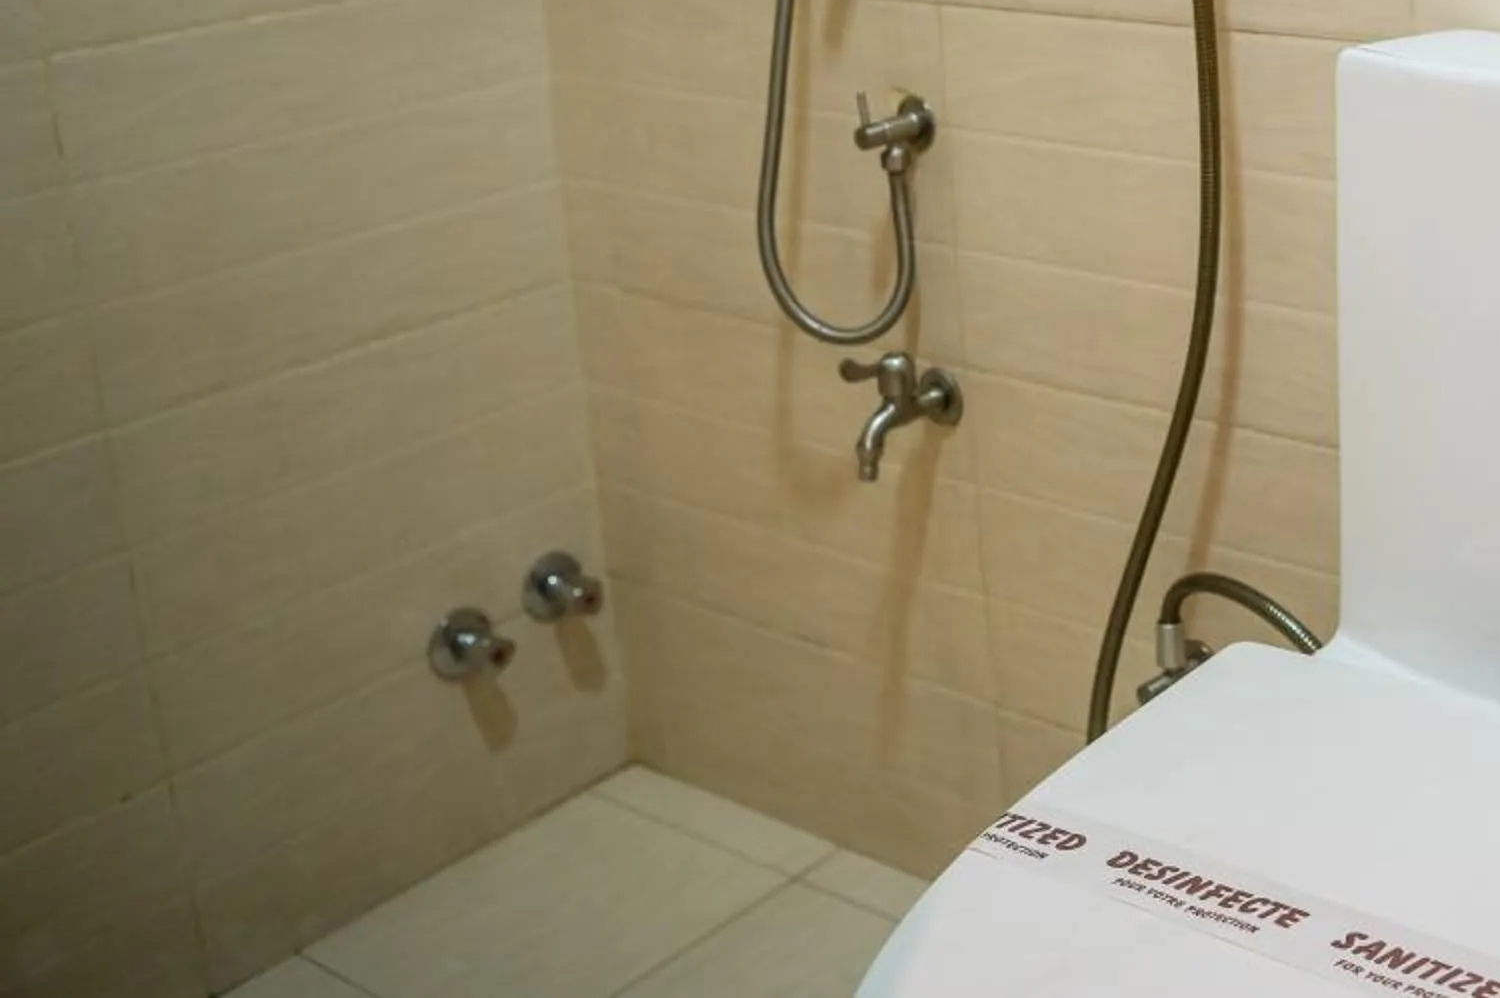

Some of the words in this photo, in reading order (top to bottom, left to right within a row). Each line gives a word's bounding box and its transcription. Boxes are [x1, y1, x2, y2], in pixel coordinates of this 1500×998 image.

[995, 813, 1088, 852] TIZED
[1105, 850, 1311, 930] DESINFECTE
[1184, 904, 1261, 935] PROTECTION
[1333, 959, 1364, 976] FOR
[1365, 970, 1403, 991] YOUR
